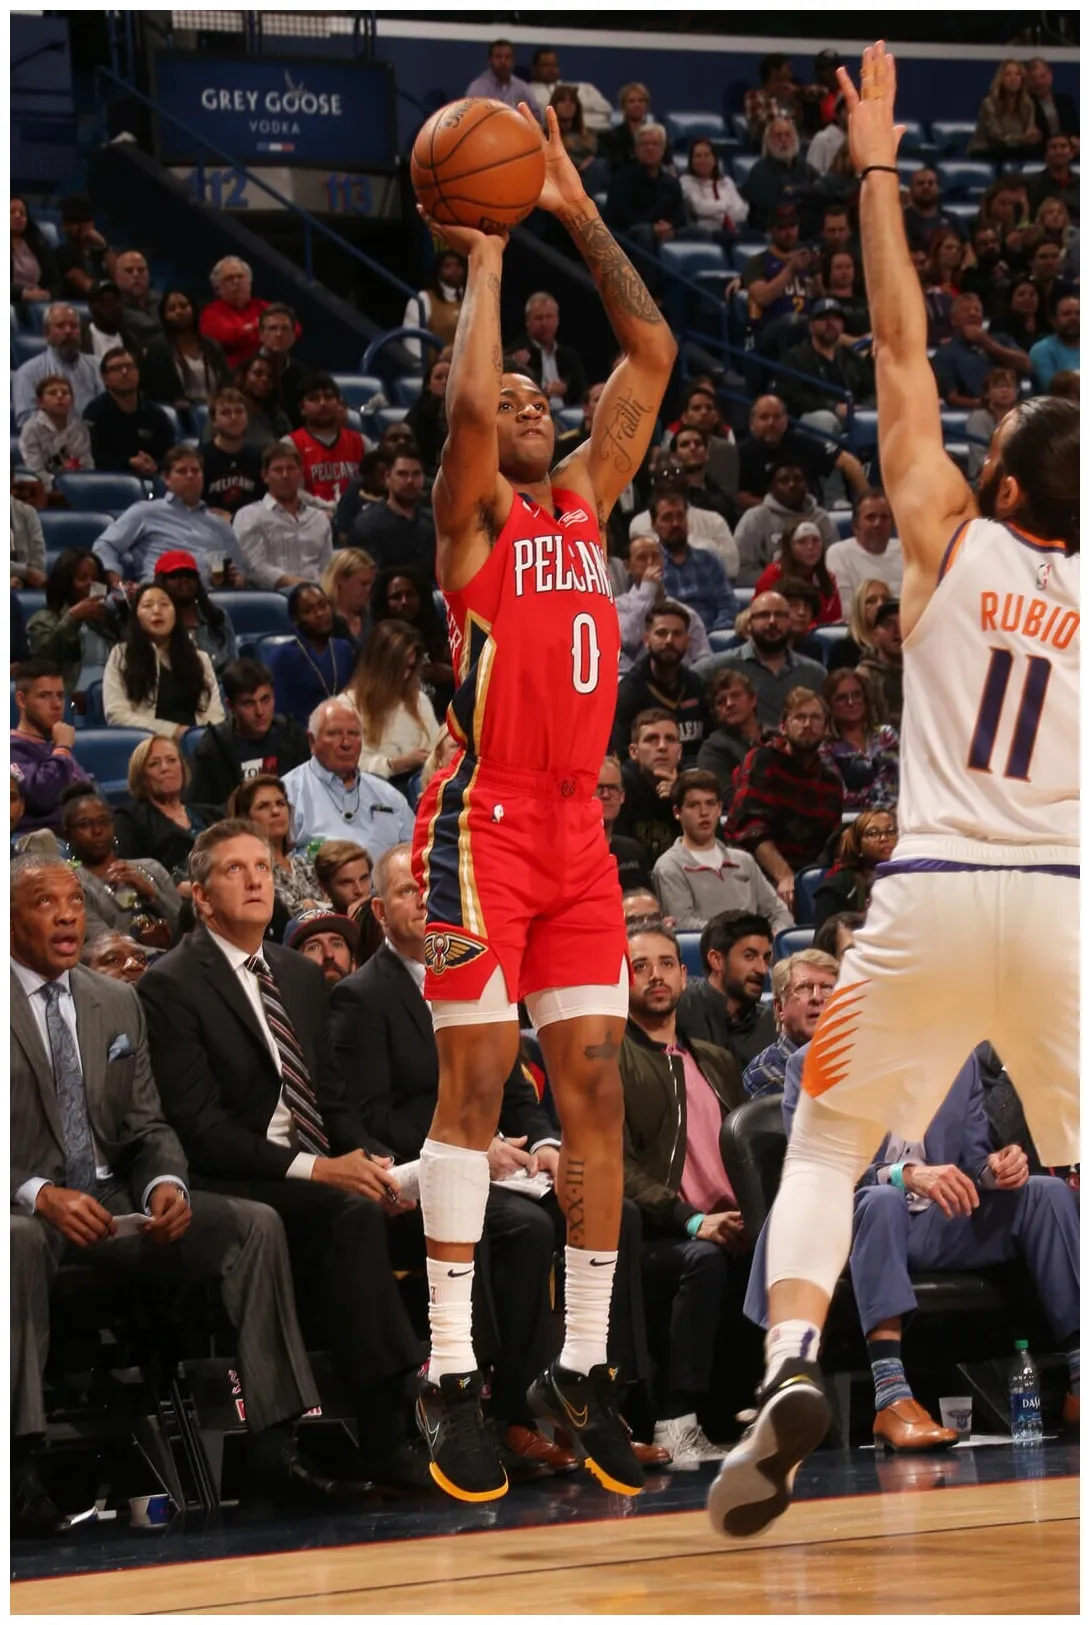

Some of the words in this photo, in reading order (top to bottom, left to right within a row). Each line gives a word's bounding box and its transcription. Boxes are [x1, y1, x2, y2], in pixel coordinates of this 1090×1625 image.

[201, 88, 259, 112] GREY
[265, 91, 342, 116] GOOSE
[249, 119, 300, 134] VODKA
[188, 168, 249, 208] 112
[319, 171, 373, 215] 113
[600, 387, 653, 473] Faith
[980, 591, 1080, 650] RUBIO
[571, 612, 600, 694] 0
[967, 646, 1052, 783] 11
